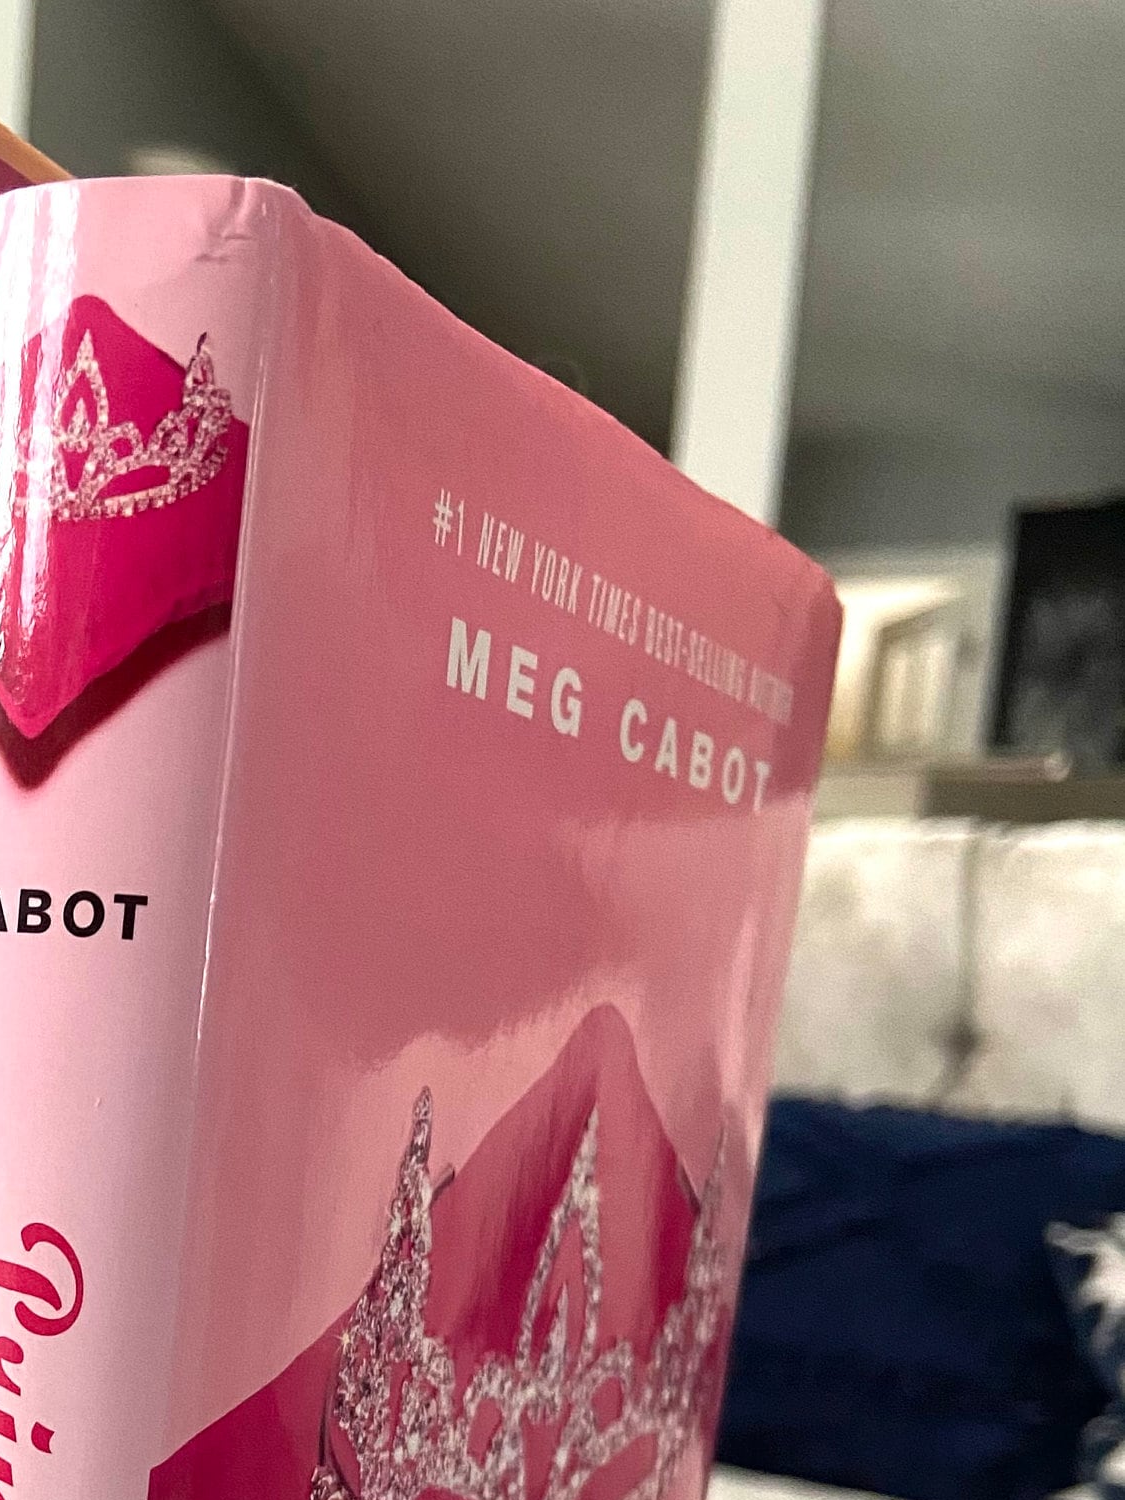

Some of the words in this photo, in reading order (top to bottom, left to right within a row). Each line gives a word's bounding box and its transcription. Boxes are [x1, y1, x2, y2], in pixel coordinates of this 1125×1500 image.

[433, 488, 465, 557] #1
[476, 512, 525, 583] NEW
[531, 541, 583, 615] YORK
[587, 573, 641, 647] TIMES
[446, 615, 583, 738] MEG
[619, 697, 771, 813] CABOT
